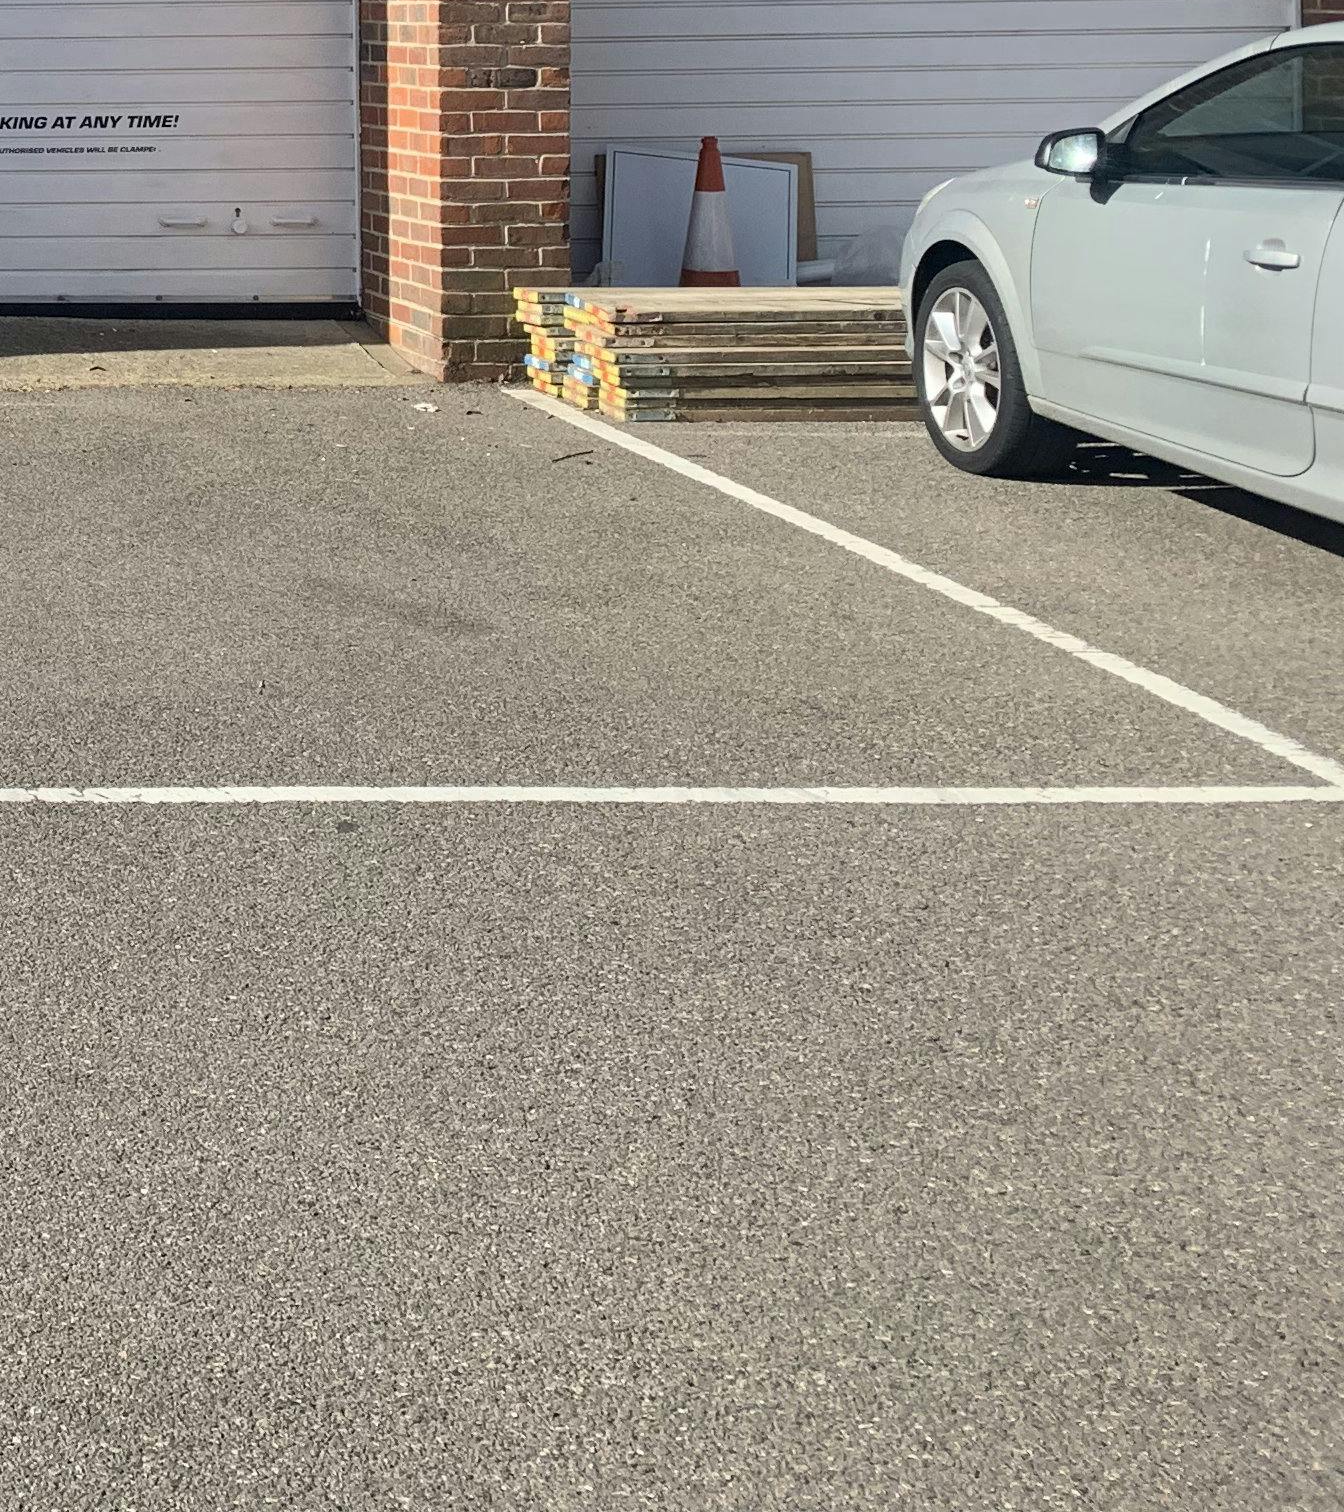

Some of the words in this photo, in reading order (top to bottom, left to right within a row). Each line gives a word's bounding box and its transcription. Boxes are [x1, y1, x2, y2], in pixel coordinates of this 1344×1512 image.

[51, 115, 77, 129] AT
[79, 115, 123, 129] ANY
[127, 114, 180, 128] TIME!
[86, 146, 106, 154] WILL
